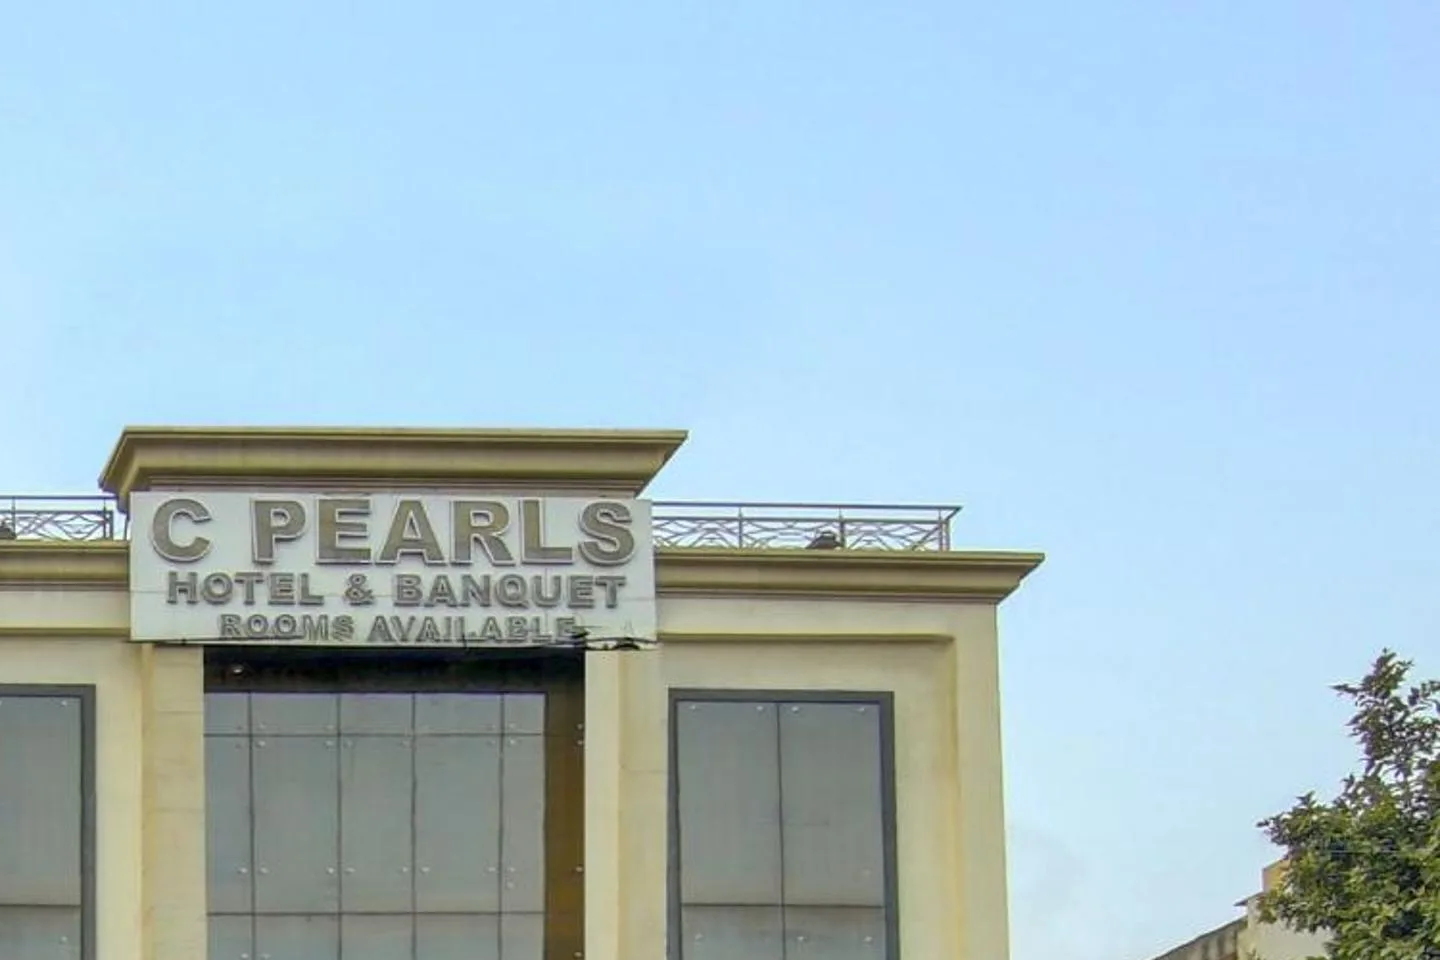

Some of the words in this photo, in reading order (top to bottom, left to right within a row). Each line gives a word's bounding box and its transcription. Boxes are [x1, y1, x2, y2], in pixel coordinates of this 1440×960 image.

[151, 499, 211, 562] C
[251, 499, 636, 566] PEARLS
[167, 571, 325, 605] HOTEL
[345, 573, 375, 605] &
[394, 573, 627, 610] BANQUET
[219, 614, 355, 641] ROOMS
[367, 615, 578, 643] AVAILABLE
